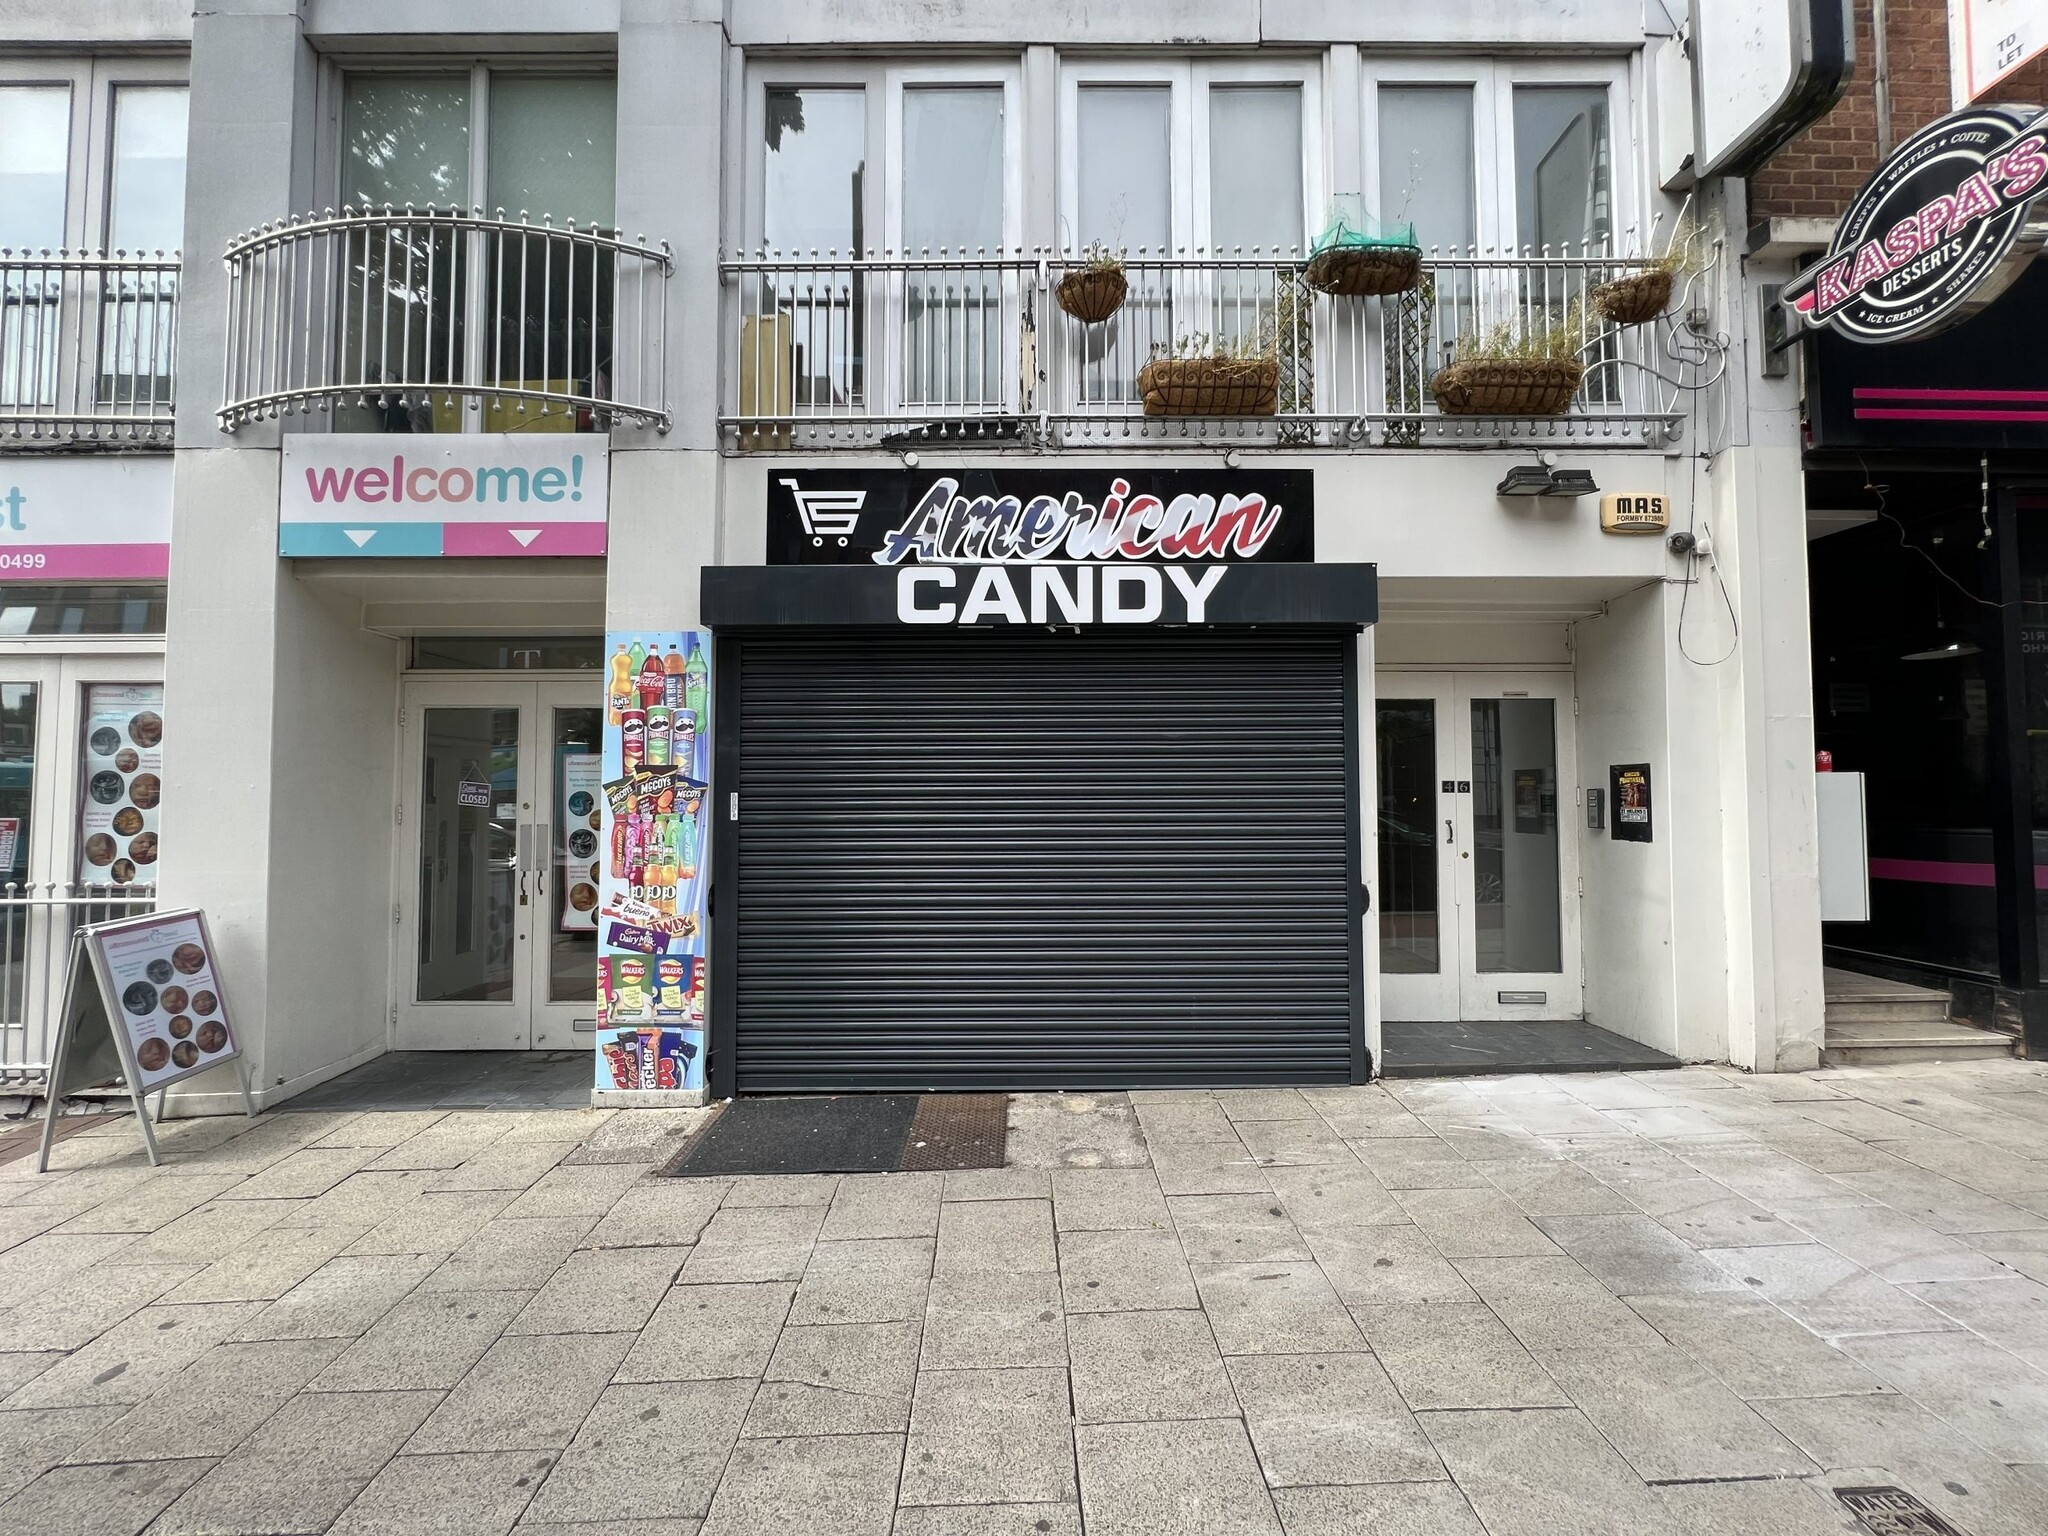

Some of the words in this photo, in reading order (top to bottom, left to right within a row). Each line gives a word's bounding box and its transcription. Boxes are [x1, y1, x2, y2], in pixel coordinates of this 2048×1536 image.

[1997, 33, 2016, 51] TO
[1998, 43, 2024, 69] LET
[1850, 196, 1877, 237] CREPES
[1888, 142, 1936, 181] WAFFLES
[1950, 132, 1990, 144] COFFEE
[1817, 135, 2047, 314] KASPA'S
[1882, 238, 1962, 297] DESSERTS
[1867, 313, 1884, 323] ICE
[1885, 304, 1924, 323] CREAM
[1946, 250, 1986, 293] SHAKES
[305, 454, 584, 503] welcome!
[0, 486, 27, 531] t
[1616, 498, 1664, 514] M.A.S.
[872, 477, 1282, 566] American
[0, 553, 46, 569] 0499
[896, 565, 1229, 624] CANDY
[623, 733, 644, 742] PRINGLES
[648, 731, 669, 740] PRINGLES
[674, 733, 694, 742] PRINGLES
[460, 793, 488, 805] CLOSED
[623, 903, 650, 917] bueno
[646, 916, 690, 934] TWIX
[619, 932, 640, 945] Dairy
[621, 965, 645, 975] WALKERS
[659, 966, 684, 975] WALKERS
[1842, 1494, 1923, 1512] WATER
